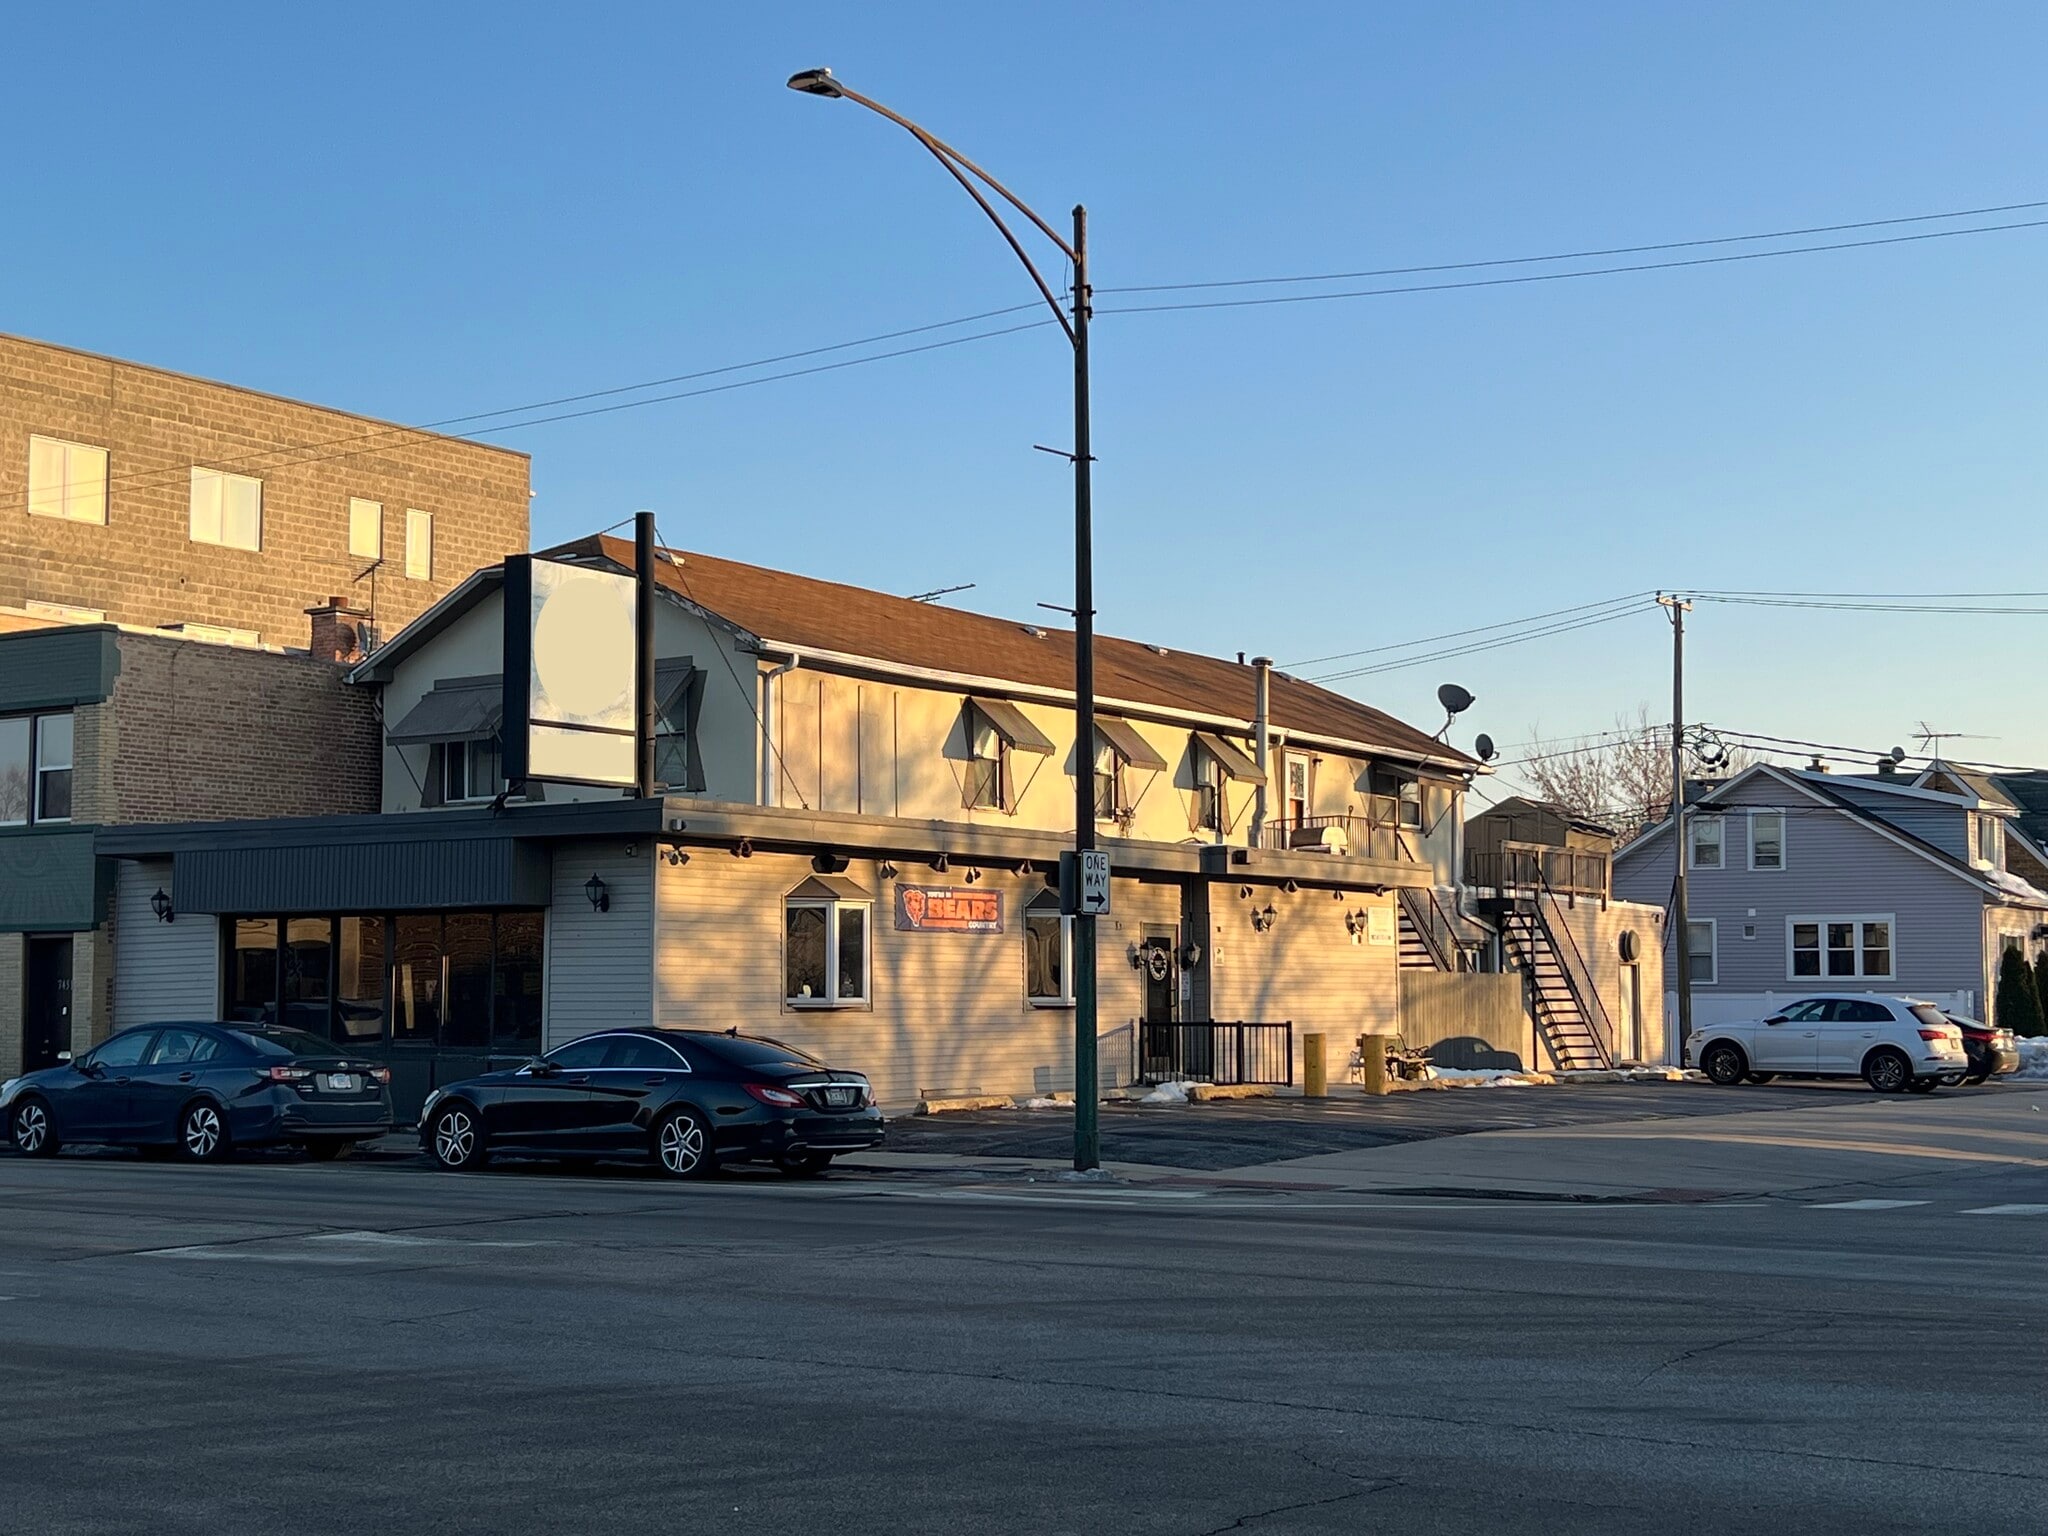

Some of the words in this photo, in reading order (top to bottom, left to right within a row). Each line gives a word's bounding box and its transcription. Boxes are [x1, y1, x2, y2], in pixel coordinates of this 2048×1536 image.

[1086, 855, 1106, 871] ONE
[1085, 873, 1107, 887] WAY
[927, 898, 998, 921] BEARS
[968, 921, 998, 929] COUNTRY
